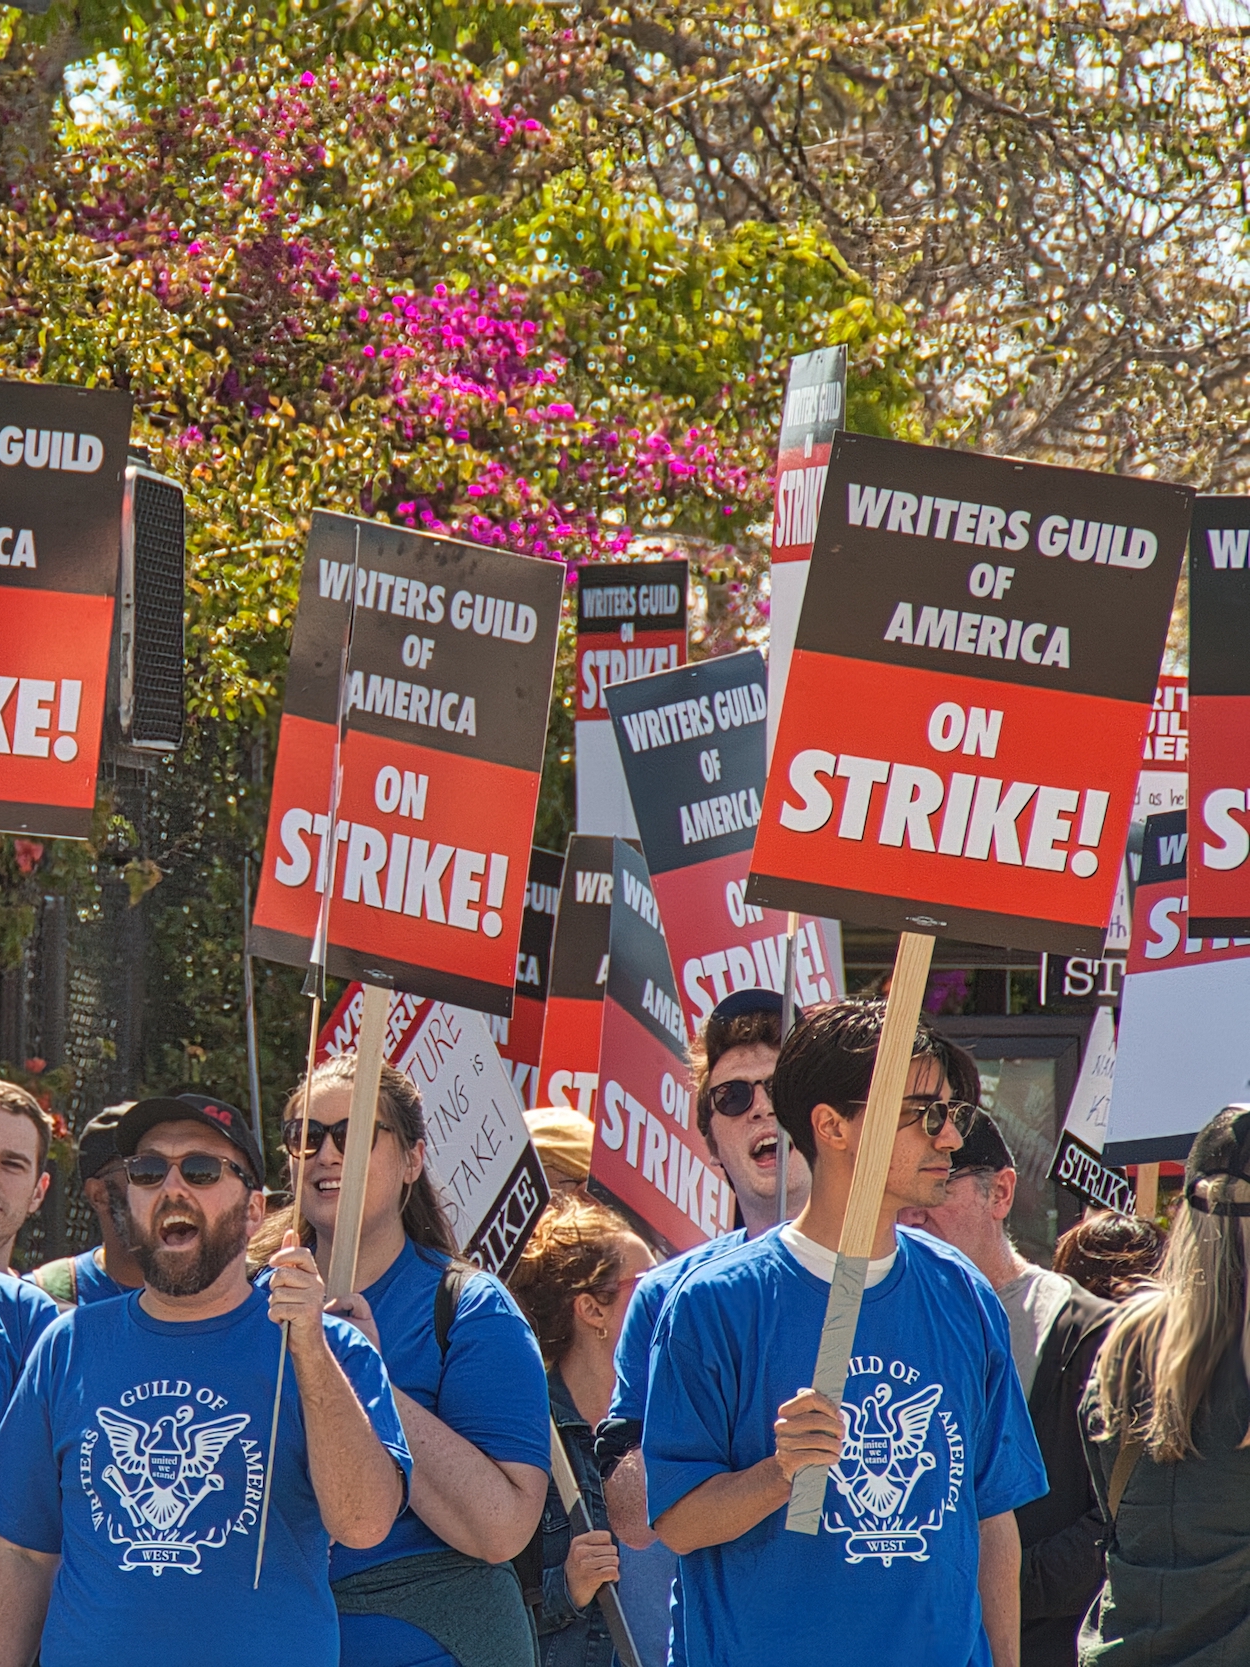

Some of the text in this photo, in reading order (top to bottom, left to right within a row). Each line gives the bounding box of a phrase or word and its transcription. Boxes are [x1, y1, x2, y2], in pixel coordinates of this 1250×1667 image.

[818, 381, 842, 422] GUILD
[775, 465, 828, 549] STRIK
[848, 483, 1031, 551] WRITERS
[1038, 514, 1158, 570] GUILD
[319, 559, 537, 644] WRITERS GUILD
[582, 584, 680, 618] WRITERS GUILD
[969, 562, 1015, 600] OF
[402, 634, 435, 670] OF
[621, 622, 634, 643] ON
[884, 602, 1070, 669] AMERICA
[347, 671, 477, 737] AMERICA
[622, 683, 767, 753] WRITERS GUILD
[928, 702, 1004, 760] ON
[375, 766, 429, 821] ON
[700, 749, 721, 783] OF
[680, 787, 762, 845] AMERICA
[779, 749, 1110, 878] STRIKE!
[1149, 793, 1162, 806] as
[275, 808, 509, 939] STRIKE!
[405, 1003, 462, 1090] TURE
[470, 1054, 484, 1076] is
[661, 1072, 690, 1131] ON
[435, 1099, 513, 1226] STAKE!
[601, 1080, 730, 1239] STRIKE!
[120, 1380, 228, 1411] GUILD OF
[847, 1356, 920, 1385] ILD OF
[151, 1456, 177, 1465] united
[863, 1440, 888, 1449] united
[865, 1455, 888, 1464] stand
[938, 1411, 964, 1512] AMERICA
[80, 1428, 104, 1532] WRITERS
[152, 1471, 175, 1480] stand
[232, 1439, 264, 1535] AMERICA
[142, 1551, 179, 1562] WEST
[867, 1540, 906, 1552] WEST
